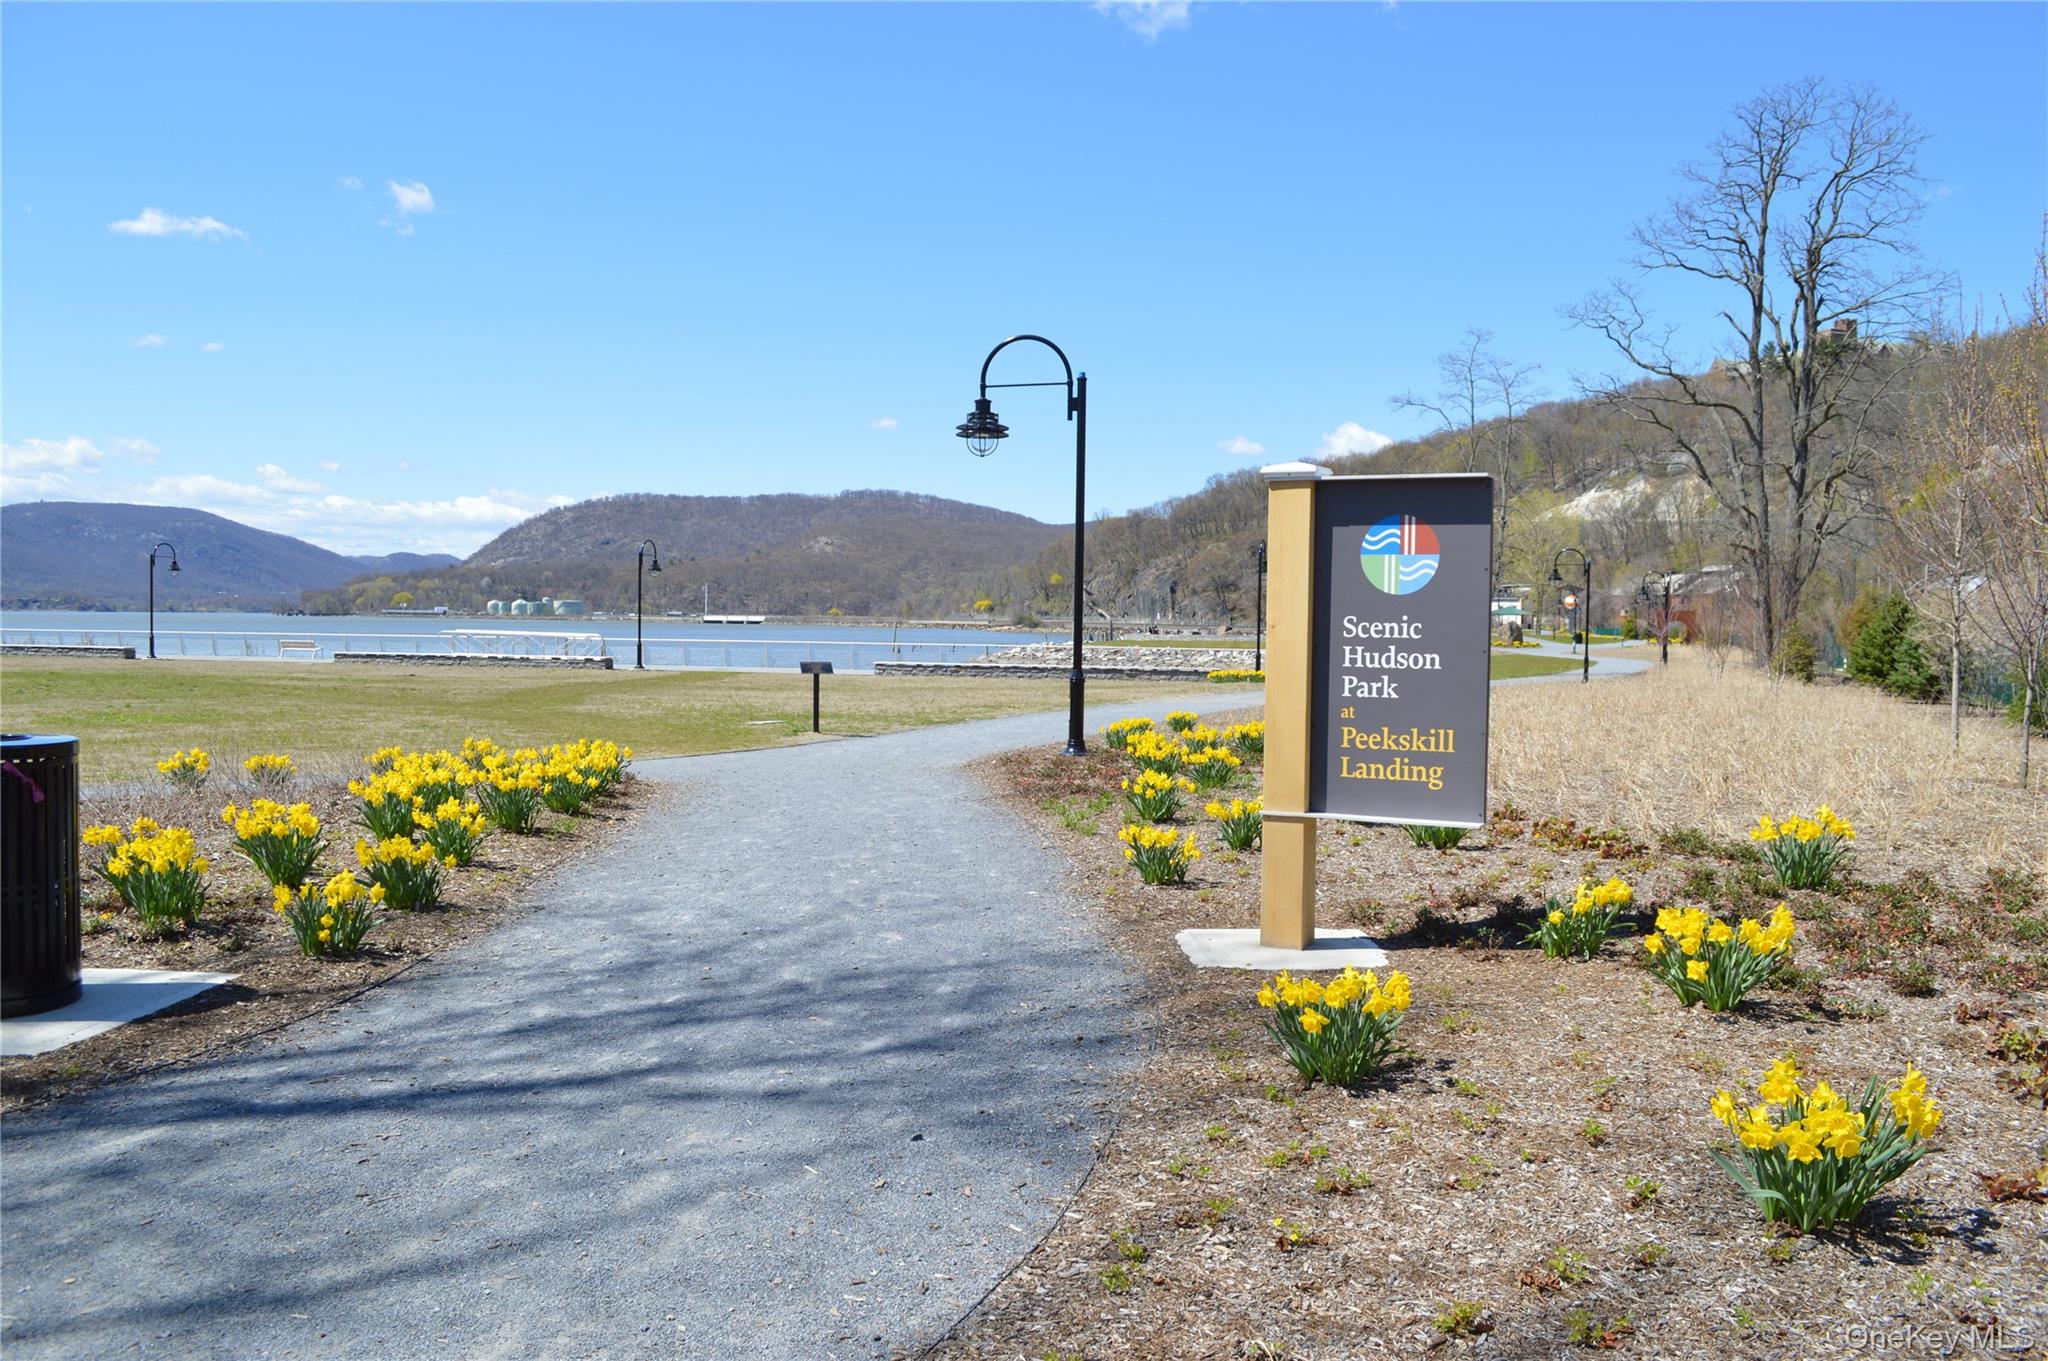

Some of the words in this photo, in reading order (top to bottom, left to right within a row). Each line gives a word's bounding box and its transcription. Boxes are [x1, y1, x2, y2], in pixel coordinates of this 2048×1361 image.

[1342, 615, 1423, 640] Scenic
[1342, 645, 1442, 670] Hudson
[1342, 675, 1400, 699] Park
[1340, 706, 1355, 719] at
[1341, 727, 1456, 753] Peekskill
[1340, 756, 1445, 791] Landing
